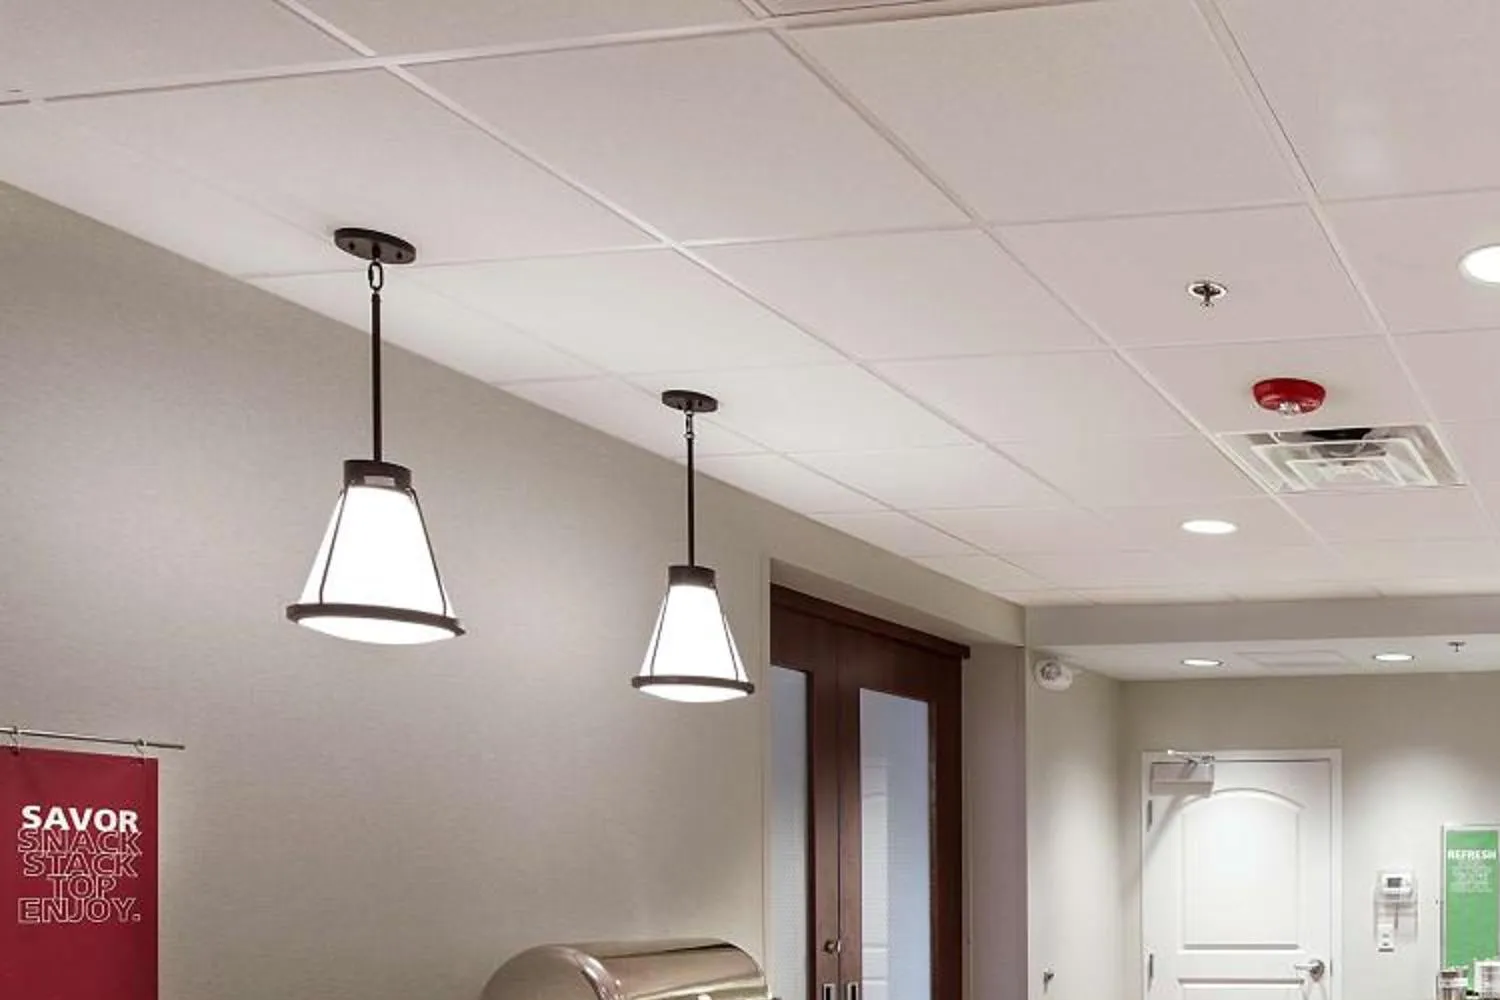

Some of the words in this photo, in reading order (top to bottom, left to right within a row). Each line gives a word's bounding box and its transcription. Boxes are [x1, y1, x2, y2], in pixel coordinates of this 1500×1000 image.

[21, 804, 139, 833] SAVOR
[17, 828, 142, 856] SNACK
[23, 851, 139, 877] STACK
[46, 872, 117, 900] TOP
[18, 897, 141, 923] ENJOY.
